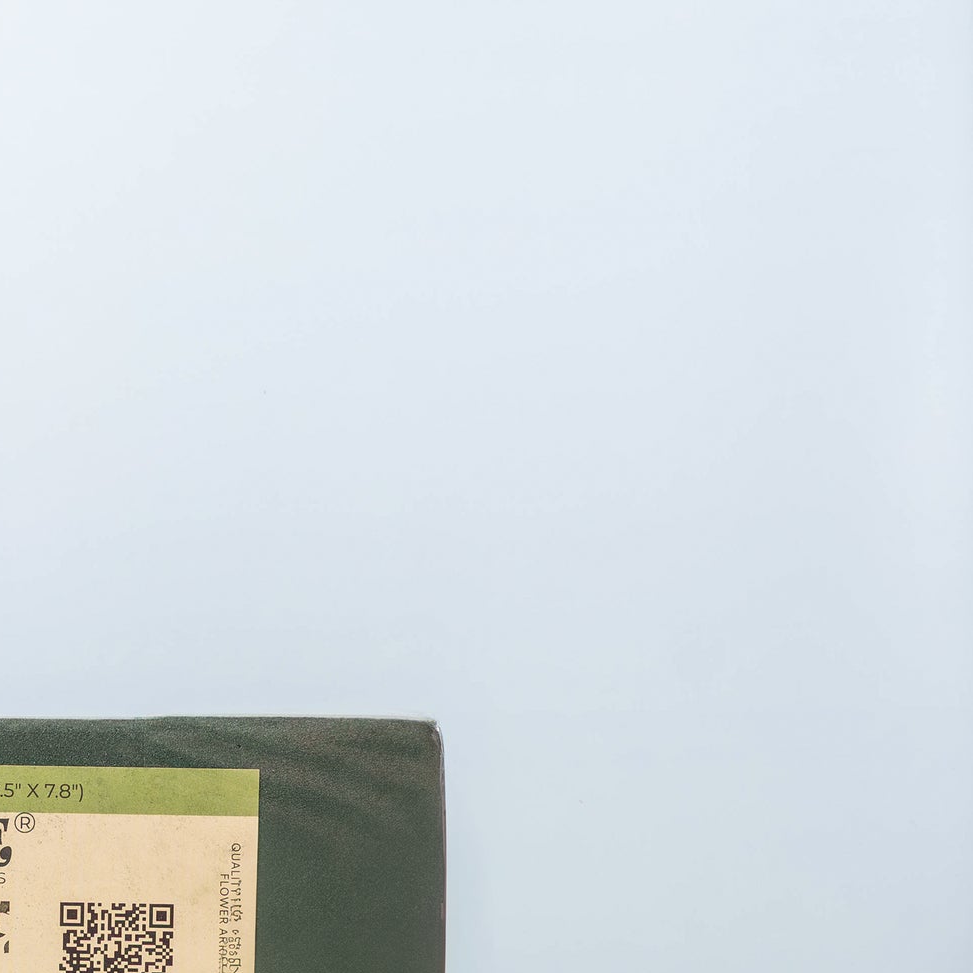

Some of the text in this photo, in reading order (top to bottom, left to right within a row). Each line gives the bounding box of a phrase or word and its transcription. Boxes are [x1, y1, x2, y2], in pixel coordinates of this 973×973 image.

[27, 783, 39, 798] X
[44, 783, 85, 802] 7.8")
[219, 873, 230, 925] FLOWER
